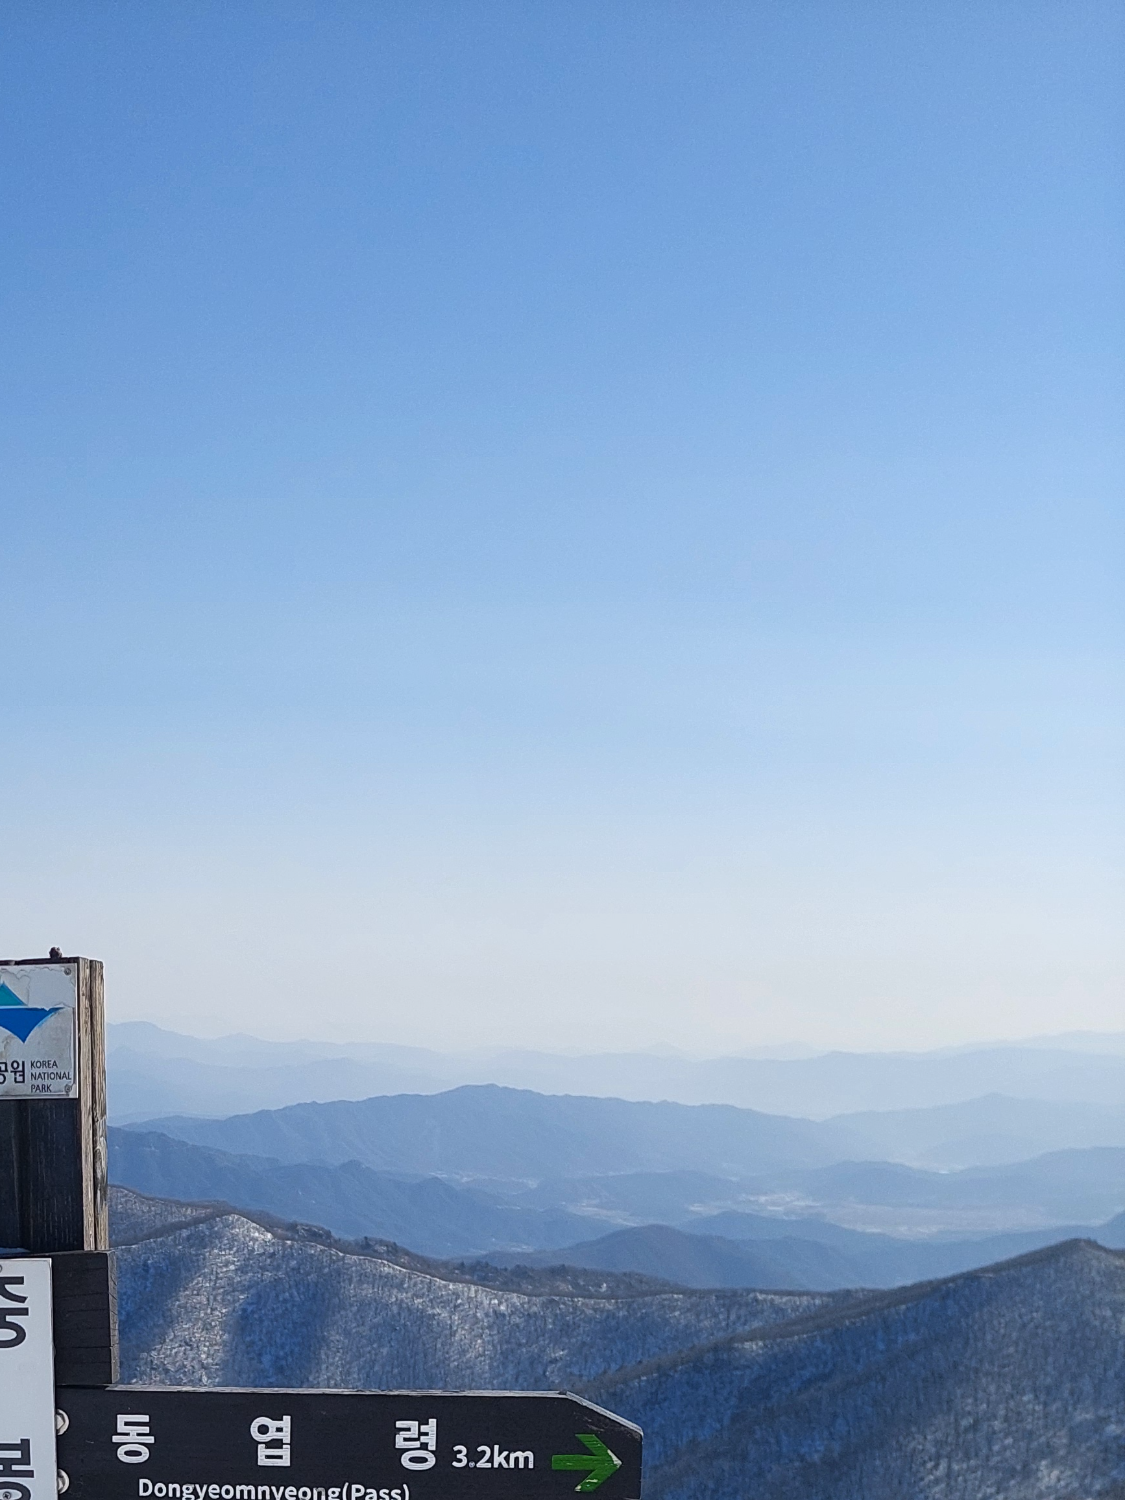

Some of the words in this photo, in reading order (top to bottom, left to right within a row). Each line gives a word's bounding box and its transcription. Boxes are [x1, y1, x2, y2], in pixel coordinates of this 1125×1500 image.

[30, 1060, 58, 1070] KOREA
[30, 1071, 72, 1081] NATIONAL
[30, 1084, 52, 1093] PARK
[451, 1445, 535, 1470] 3.2km
